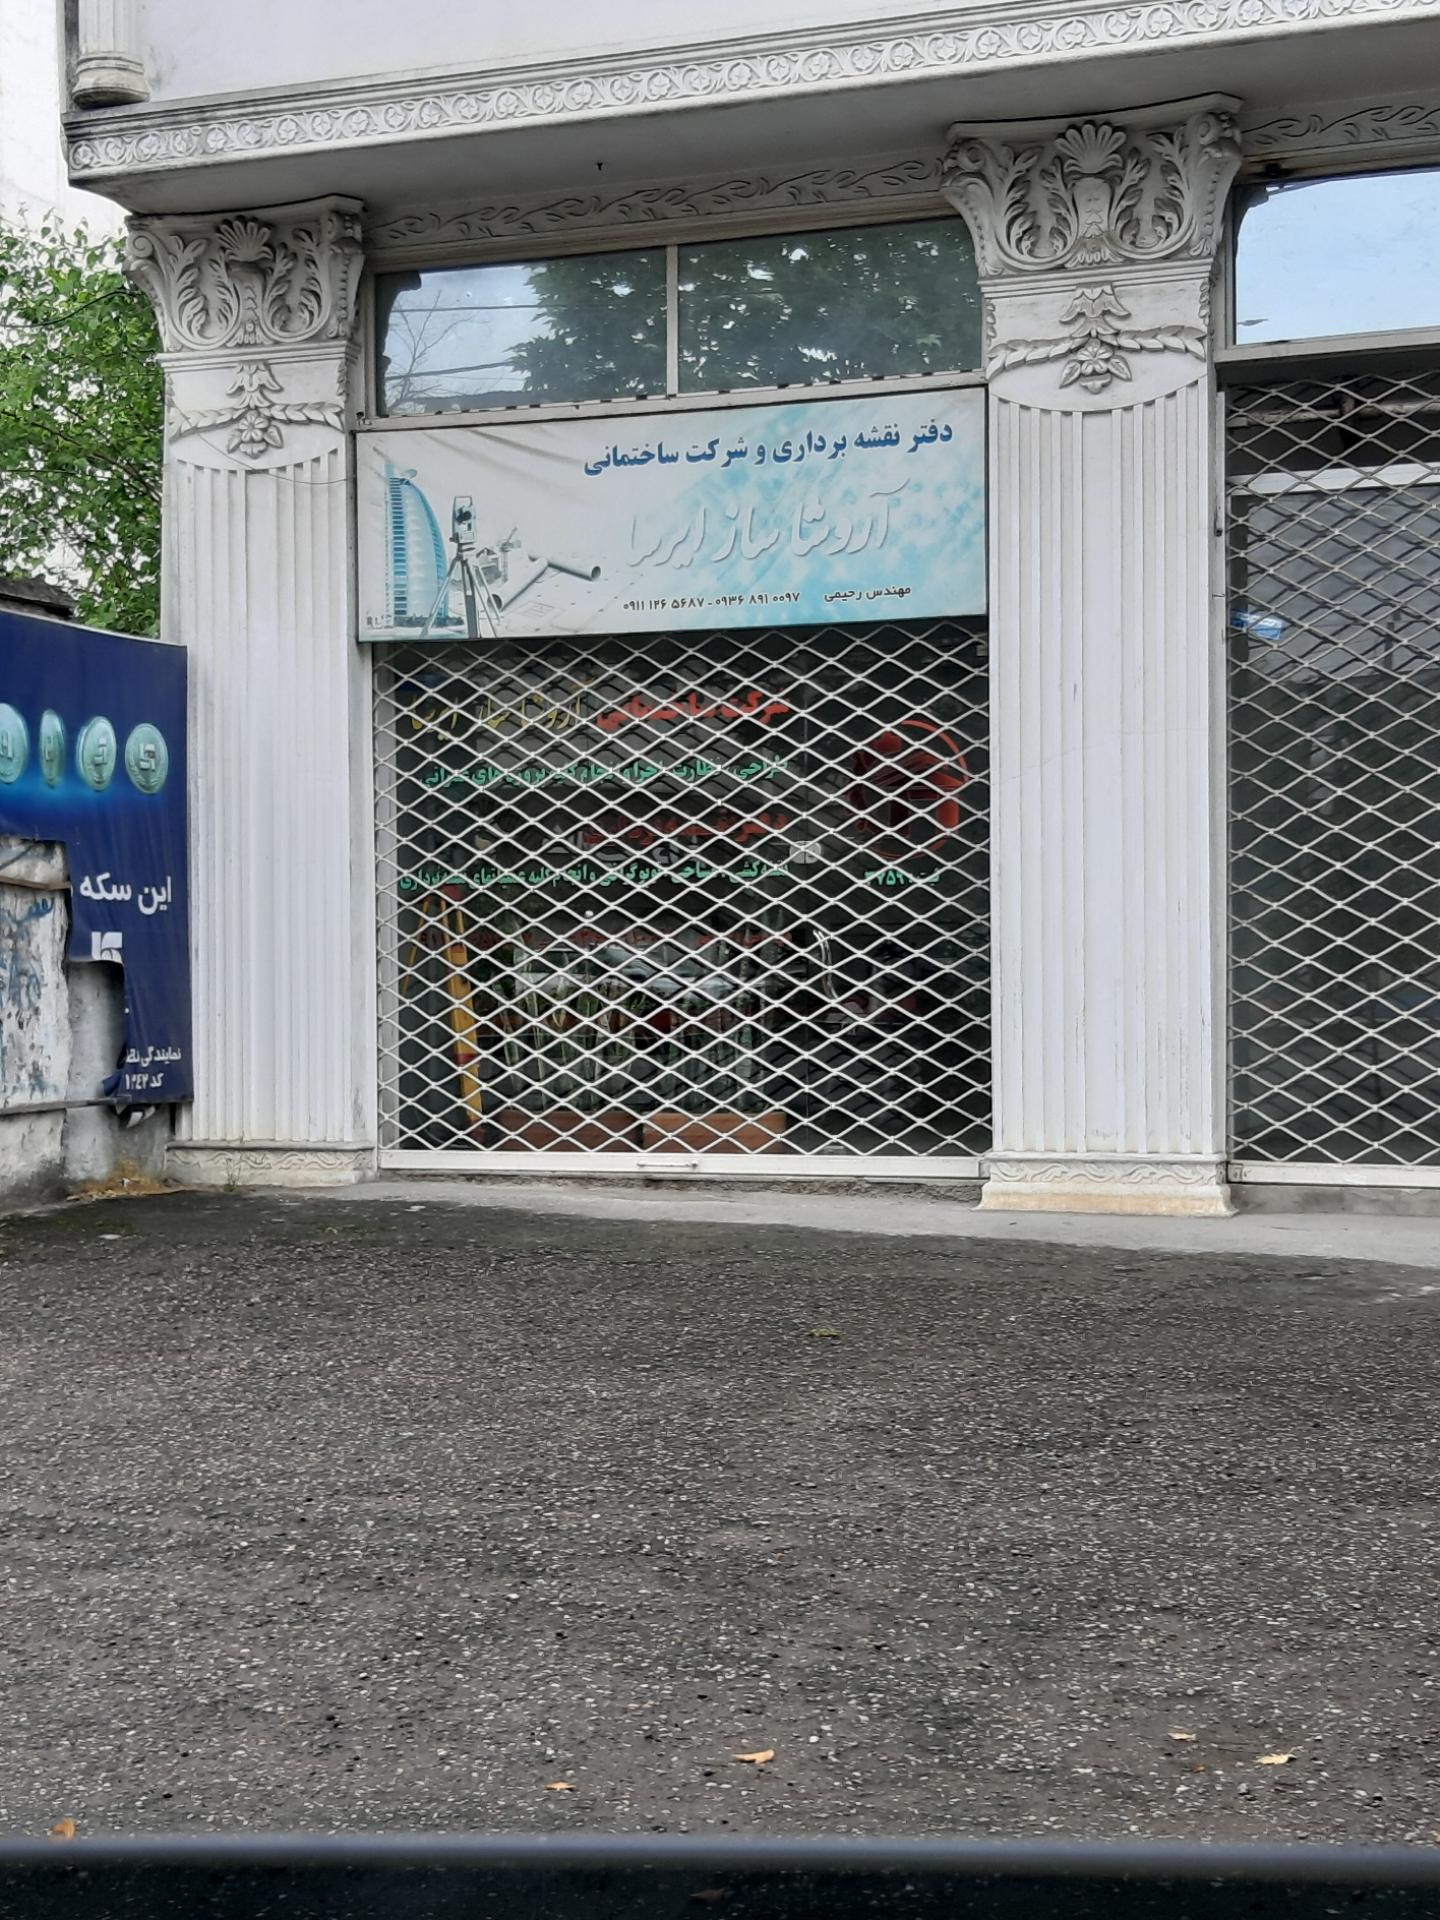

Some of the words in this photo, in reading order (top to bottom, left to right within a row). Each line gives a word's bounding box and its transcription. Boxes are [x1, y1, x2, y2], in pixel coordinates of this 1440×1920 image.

[772, 430, 847, 463] برداری
[853, 423, 900, 449] نقشه
[907, 418, 953, 454] دفتر
[584, 441, 680, 476] ساختمانی
[685, 437, 749, 468] شرکت
[754, 444, 767, 465] و
[711, 504, 781, 563] ساز
[623, 600, 645, 611] ۰۹۱۱
[671, 598, 705, 609] ۵۶۸۷
[715, 595, 745, 606] ۰۹۳۶
[749, 594, 769, 605] ۸۹۱
[772, 592, 801, 603] ۰۰۹۷
[823, 589, 863, 603] رحیمی
[866, 586, 911, 600] مهندس
[80, 872, 132, 901] سکه
[138, 876, 172, 915] این
[141, 1045, 182, 1067] نمایندگی
[150, 1072, 165, 1088] کد
